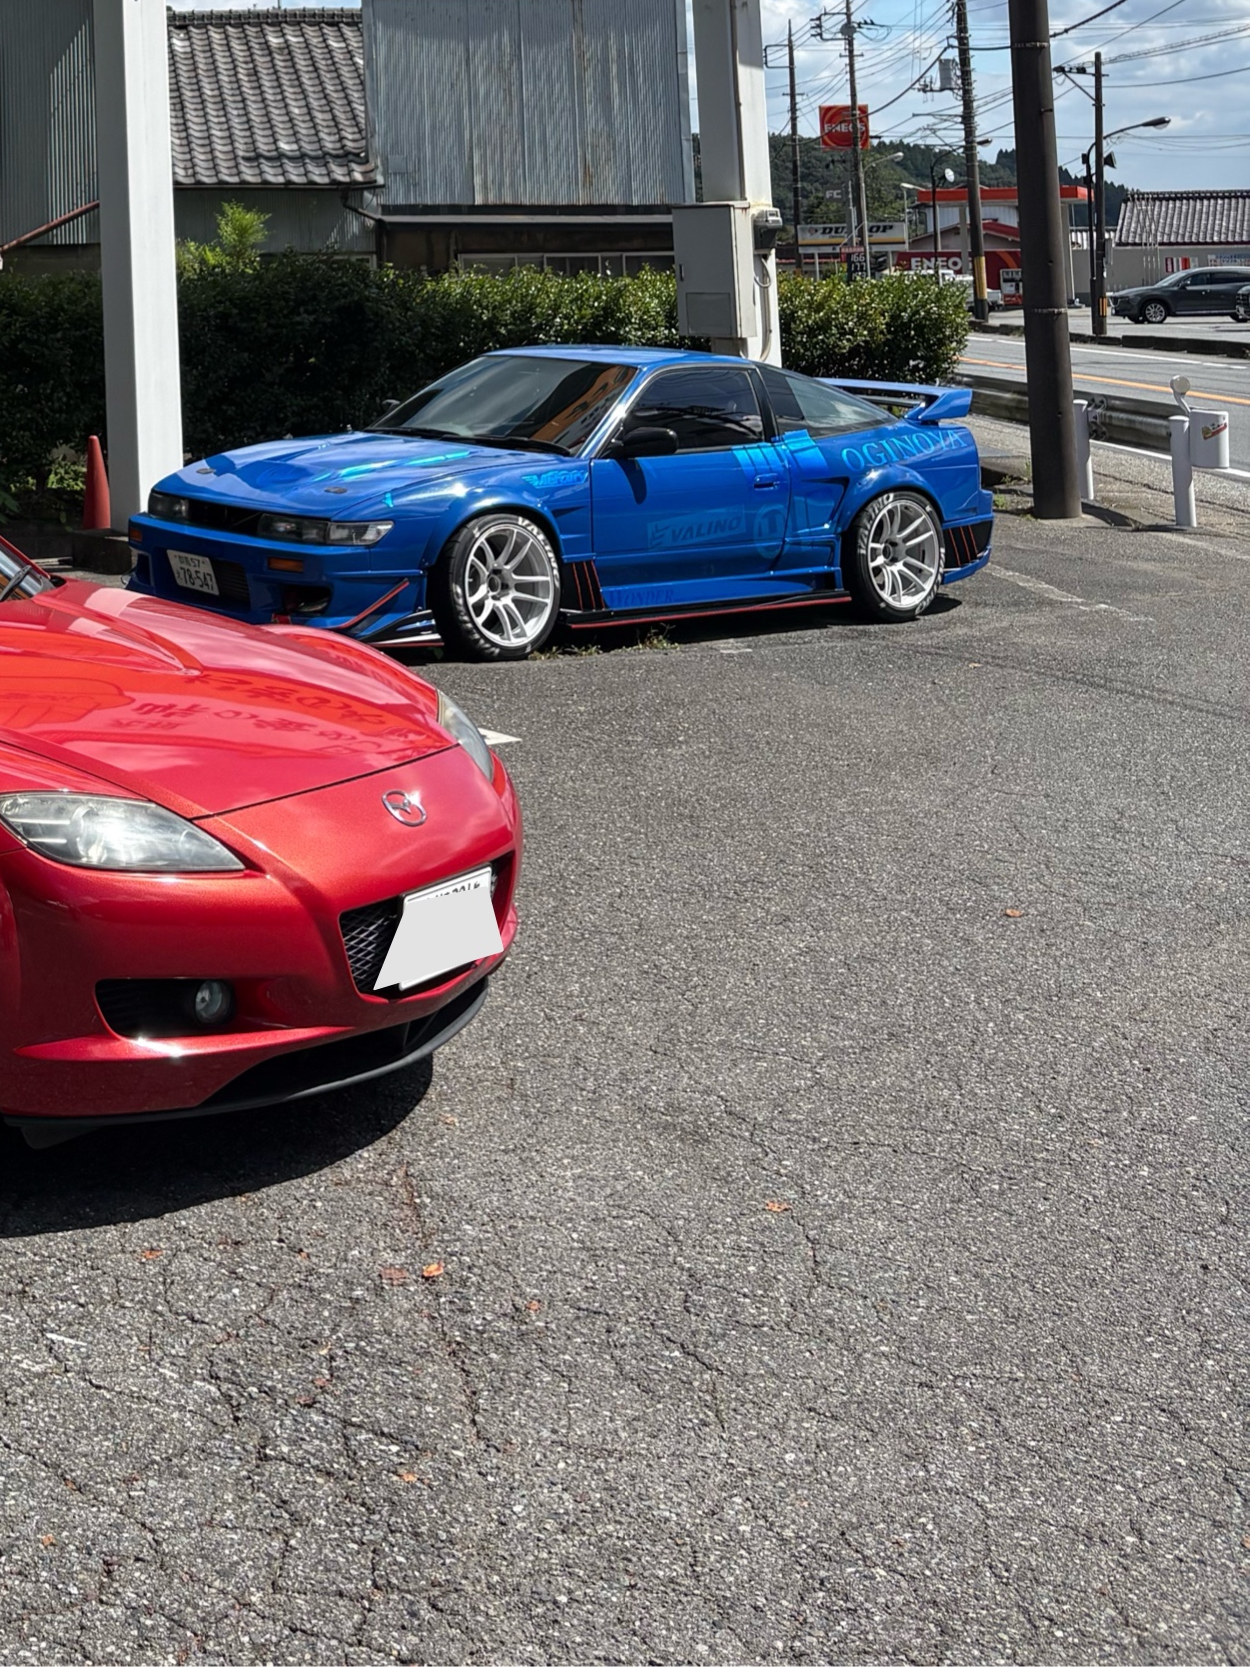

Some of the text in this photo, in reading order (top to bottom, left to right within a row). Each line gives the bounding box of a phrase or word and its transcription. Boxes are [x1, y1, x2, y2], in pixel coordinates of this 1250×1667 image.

[820, 224, 893, 235] DUOP
[911, 256, 972, 271] ENEO
[841, 428, 967, 472] OGINOYA
[671, 516, 741, 543] VALINO
[517, 516, 560, 590] VALINO
